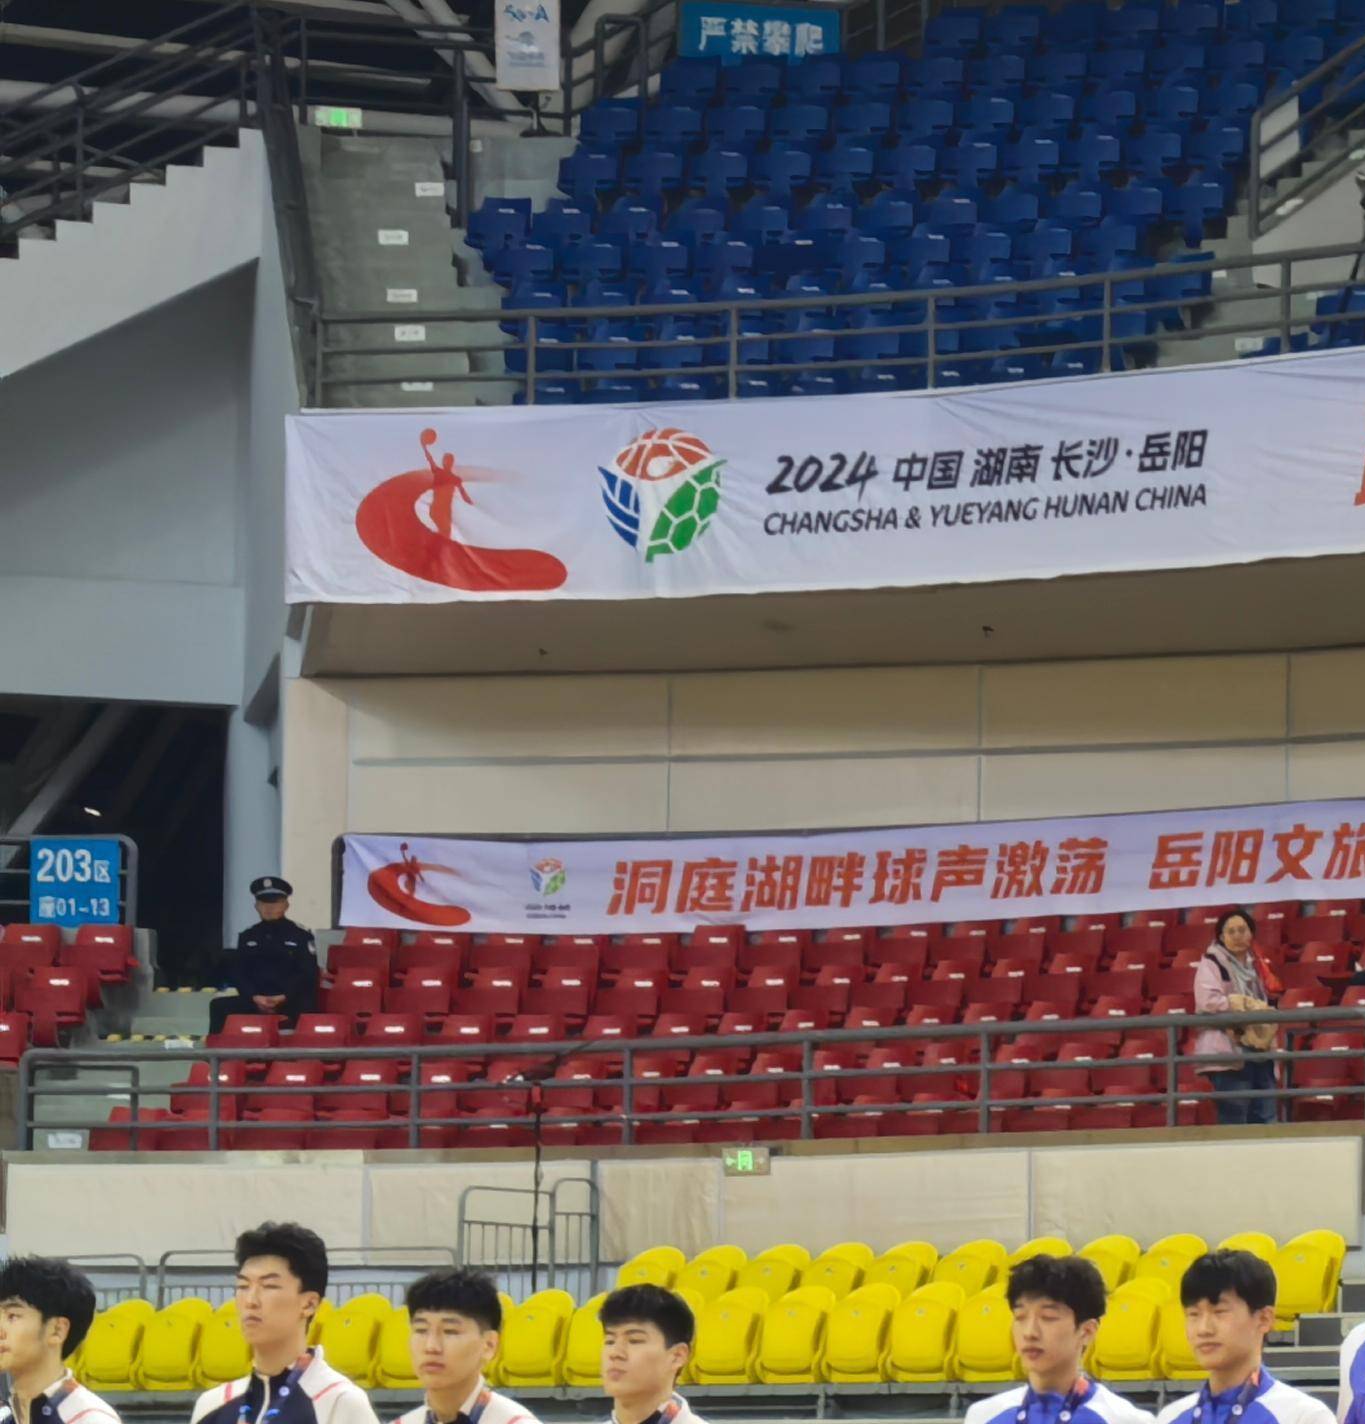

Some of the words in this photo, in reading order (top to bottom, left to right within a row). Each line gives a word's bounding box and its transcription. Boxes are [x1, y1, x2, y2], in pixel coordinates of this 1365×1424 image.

[765, 451, 878, 501] 2024
[892, 450, 964, 492] 中国
[970, 444, 1043, 487] 湖南
[763, 507, 898, 536] CHANGSHA
[905, 507, 921, 530] &
[930, 497, 1040, 528] YUEYANG
[1044, 489, 1129, 520] HUNAN
[1135, 483, 1208, 511] CHINA
[37, 848, 111, 883] 203区
[606, 836, 1108, 916] 洞庭湖畔球声激荡
